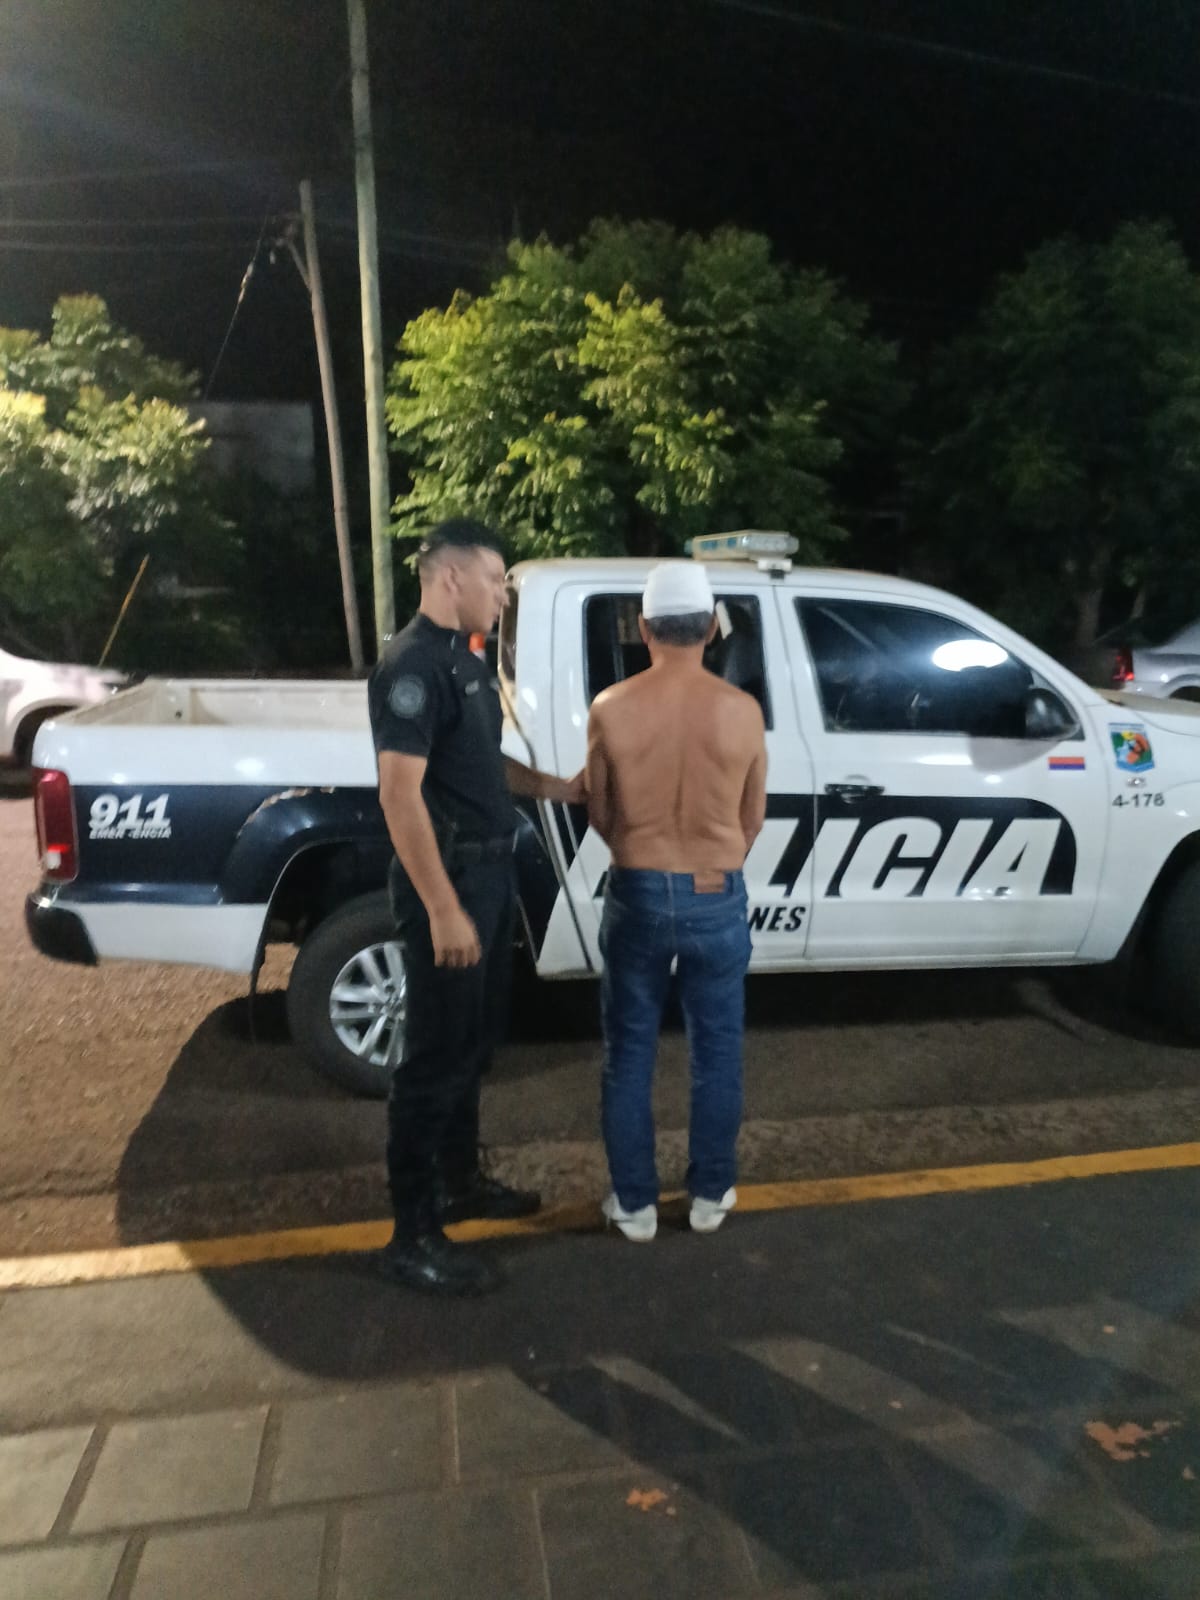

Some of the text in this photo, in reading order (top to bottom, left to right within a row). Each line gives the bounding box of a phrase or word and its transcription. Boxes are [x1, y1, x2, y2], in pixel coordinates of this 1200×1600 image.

[88, 793, 171, 829] 911
[1111, 793, 1165, 808] 4-178
[562, 816, 1062, 899] LICIA
[748, 906, 806, 932] NES
